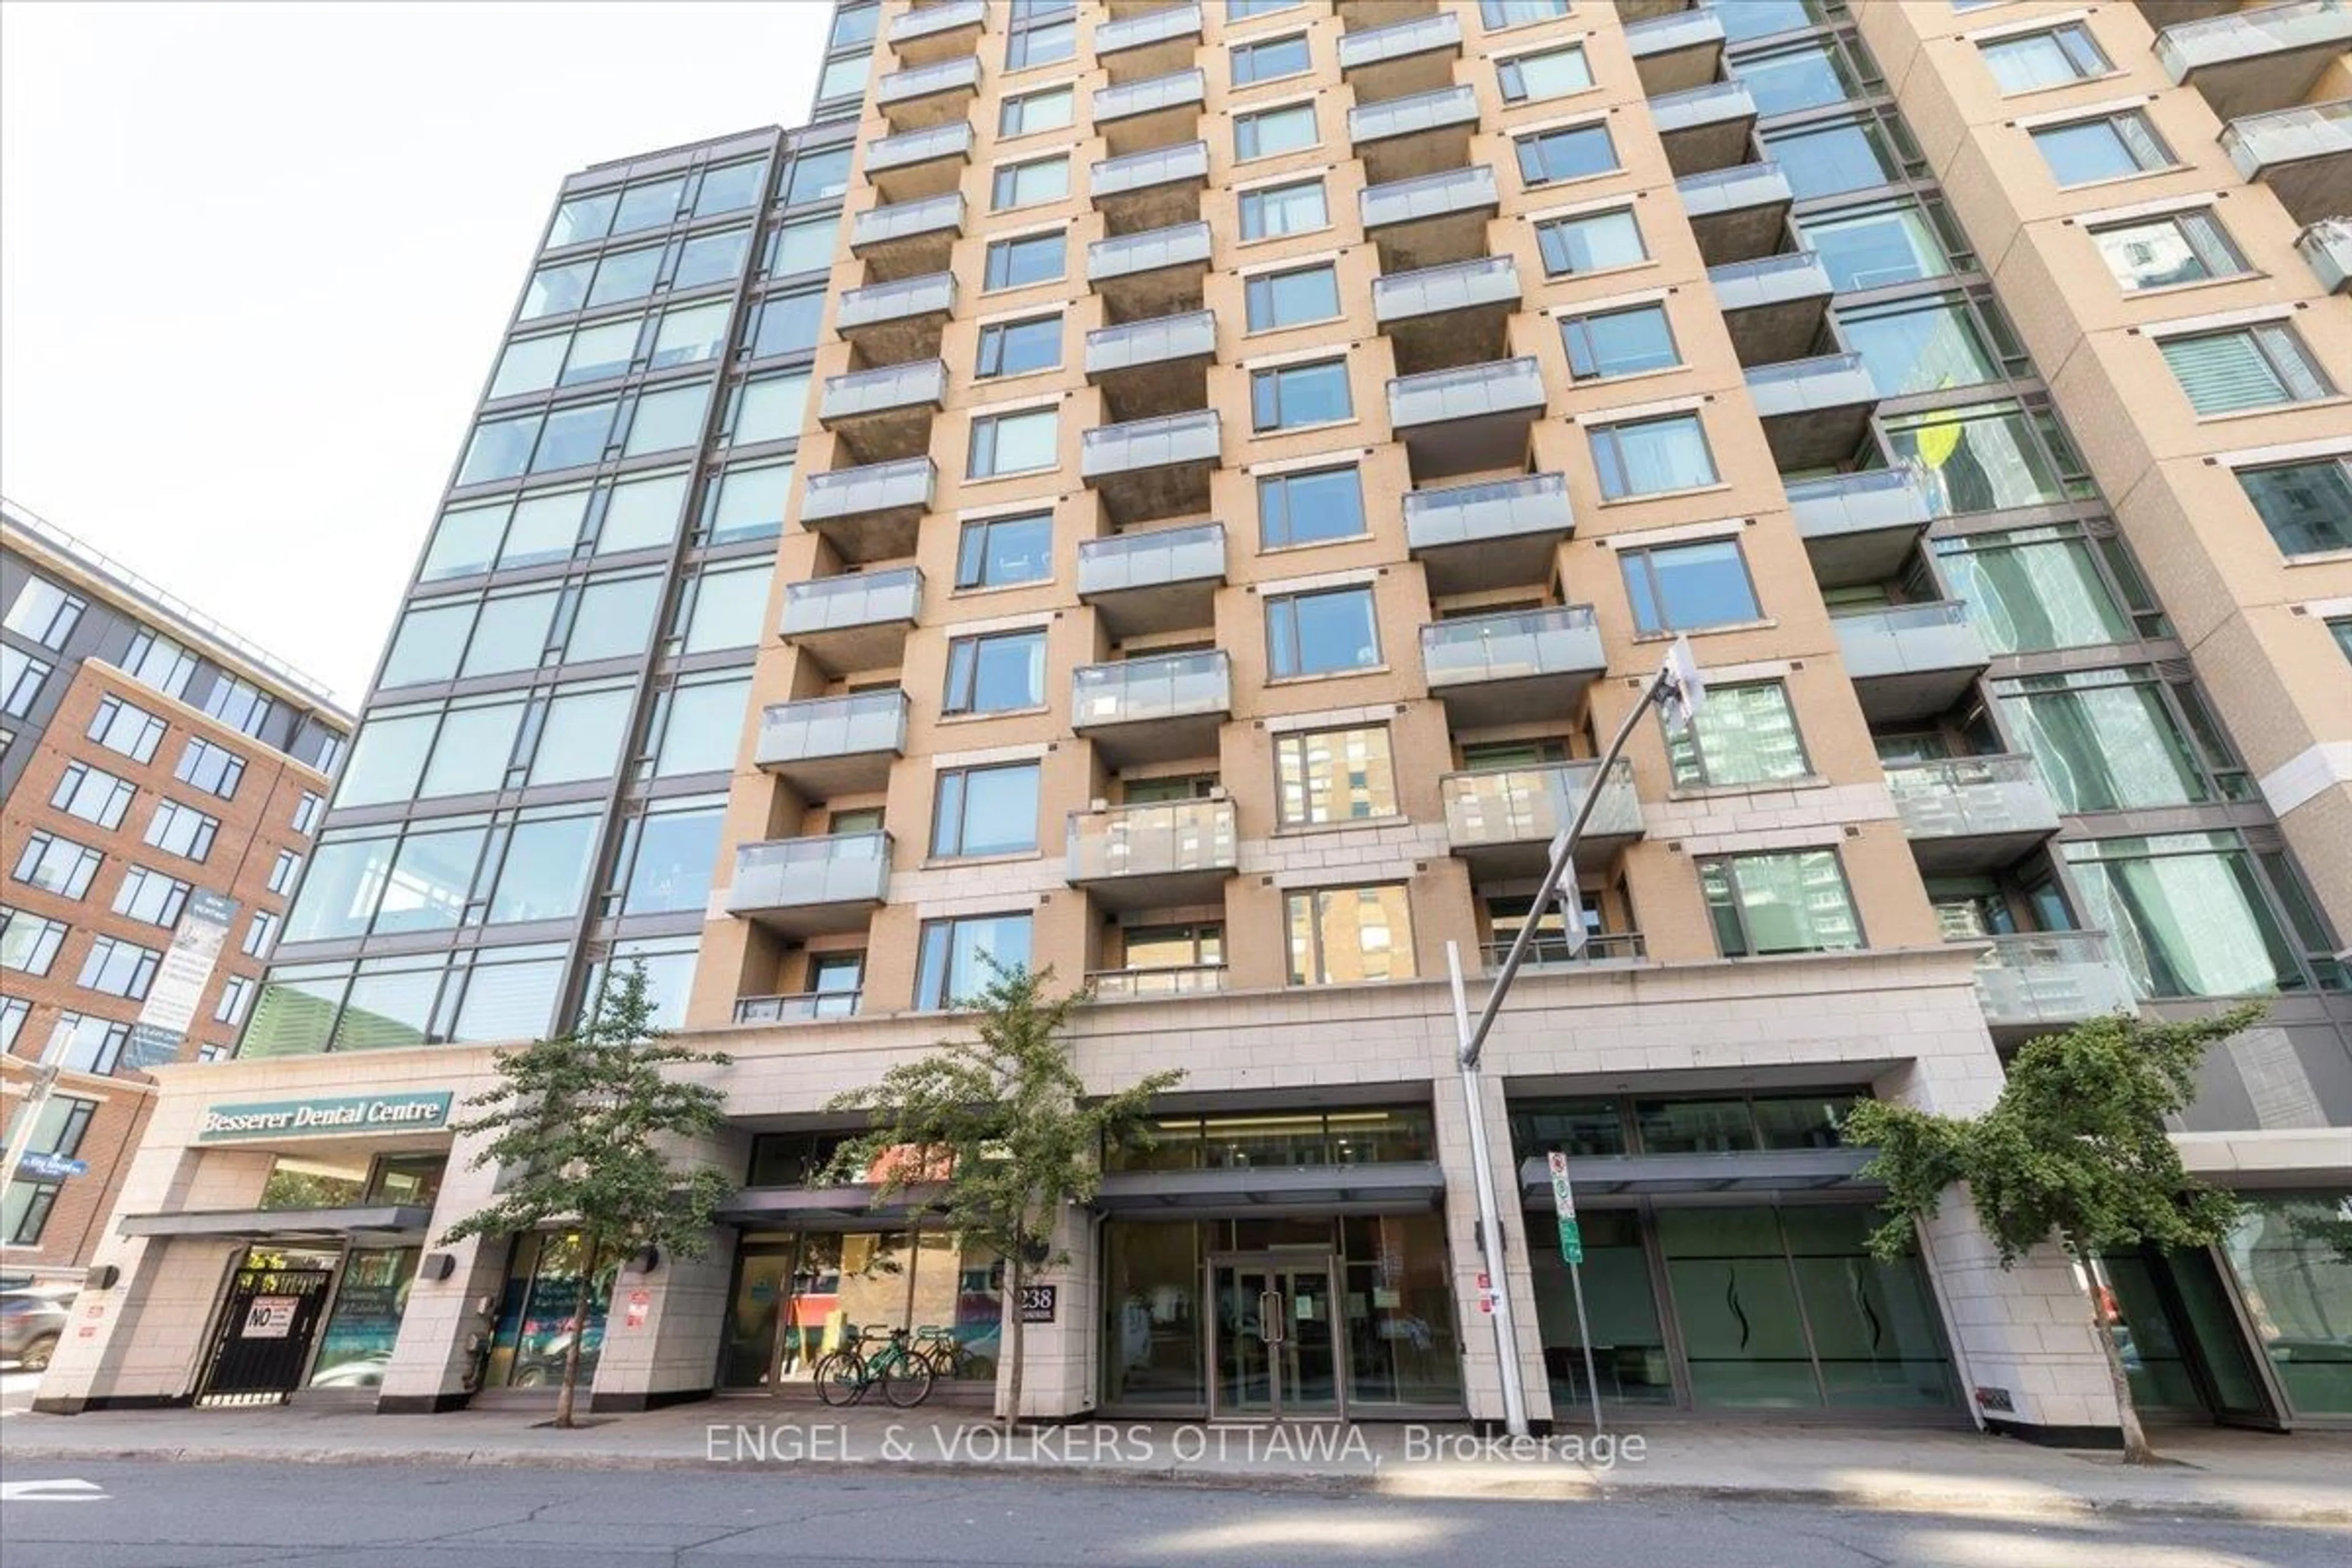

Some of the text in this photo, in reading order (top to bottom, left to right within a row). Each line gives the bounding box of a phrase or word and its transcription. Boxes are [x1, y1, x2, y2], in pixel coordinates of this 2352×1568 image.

[204, 1101, 440, 1132] Besserer Dental Centre
[1018, 1289, 1052, 1308] 238
[248, 1307, 271, 1327] NO
